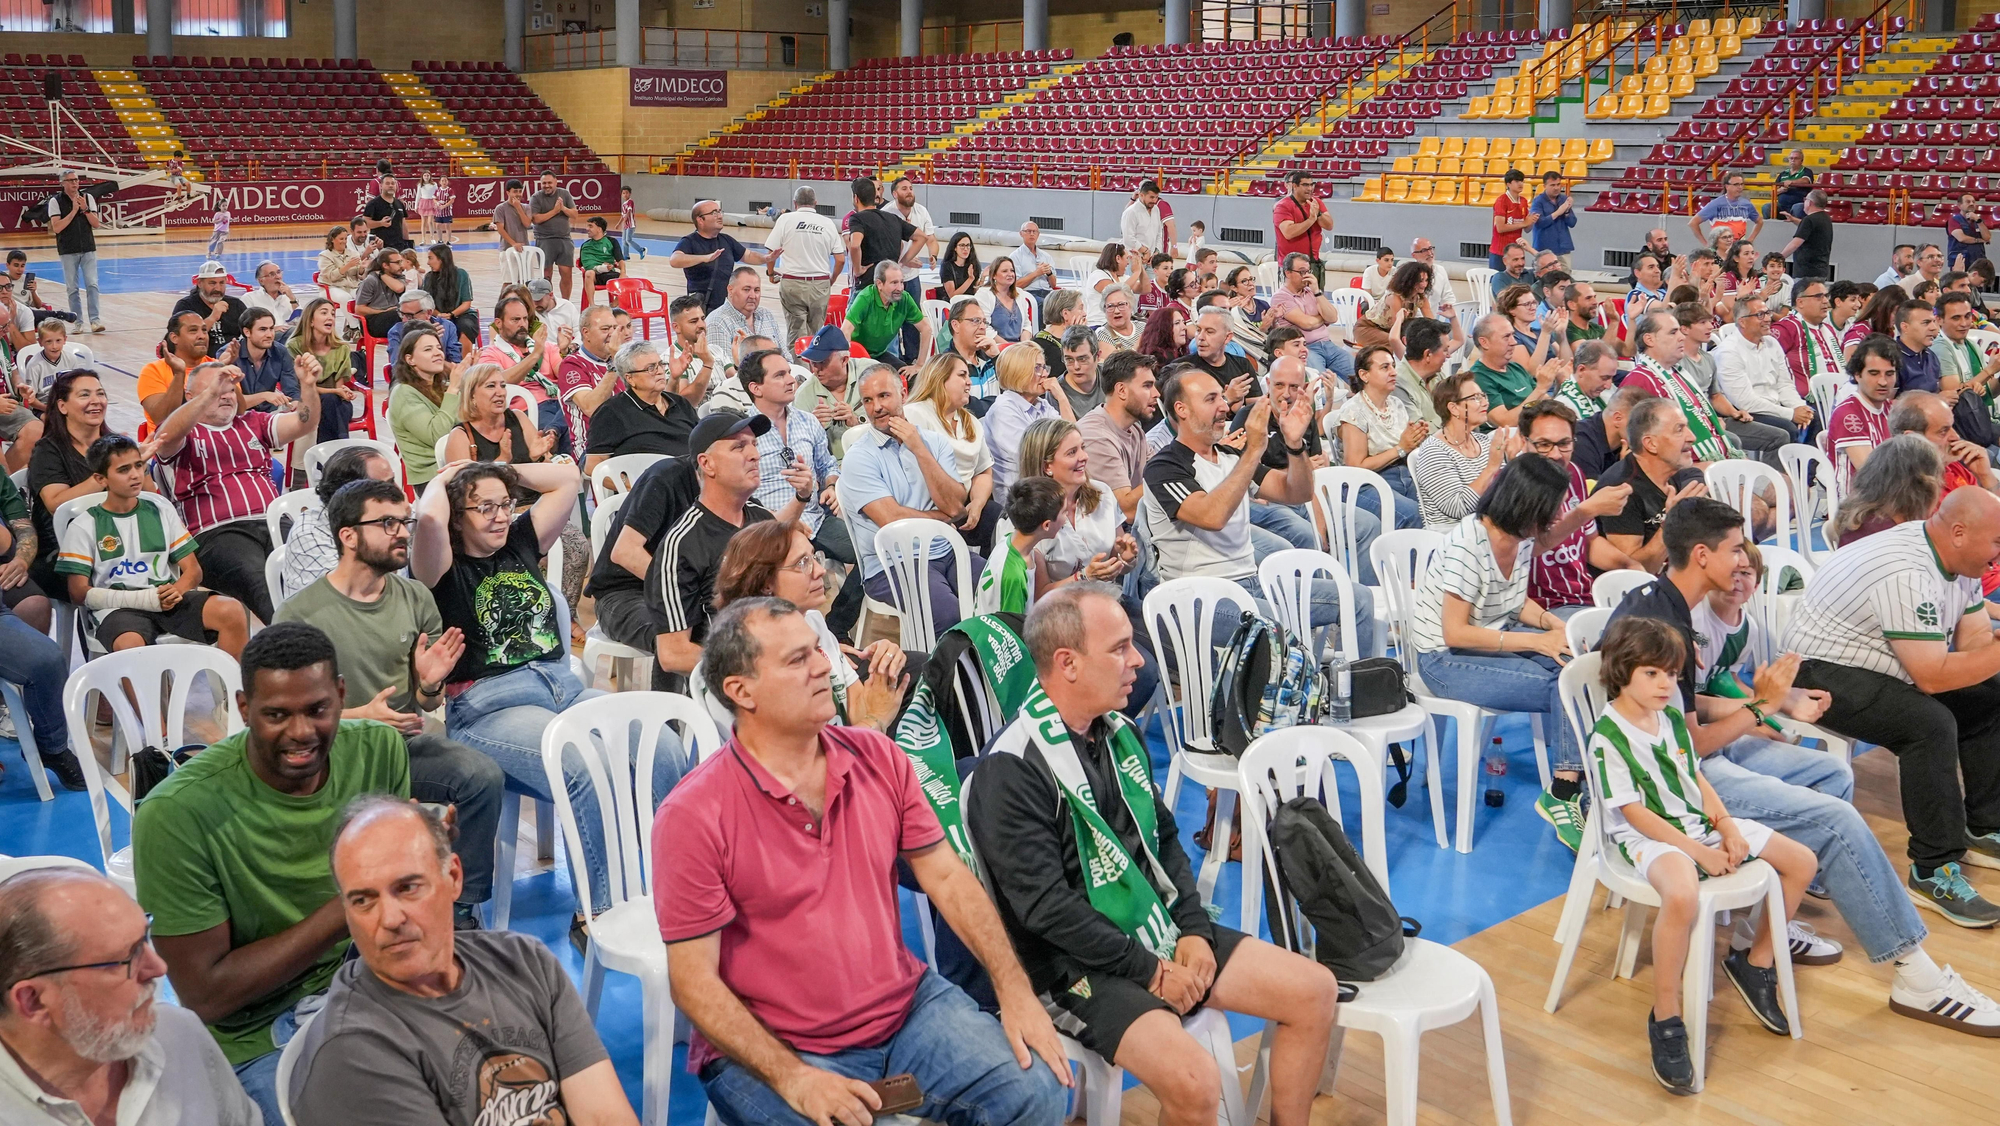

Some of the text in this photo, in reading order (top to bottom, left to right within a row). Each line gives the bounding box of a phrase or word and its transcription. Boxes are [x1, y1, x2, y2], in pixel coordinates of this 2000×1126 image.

[655, 77, 724, 94] IMDECO
[165, 217, 198, 225] Instituto
[242, 215, 252, 223] de
[254, 214, 290, 224] Deportes
[293, 213, 324, 221] Córdoba
[980, 615, 1023, 664] BALONCESTO
[993, 662, 1004, 685] POR
[1089, 857, 1108, 888] POR
